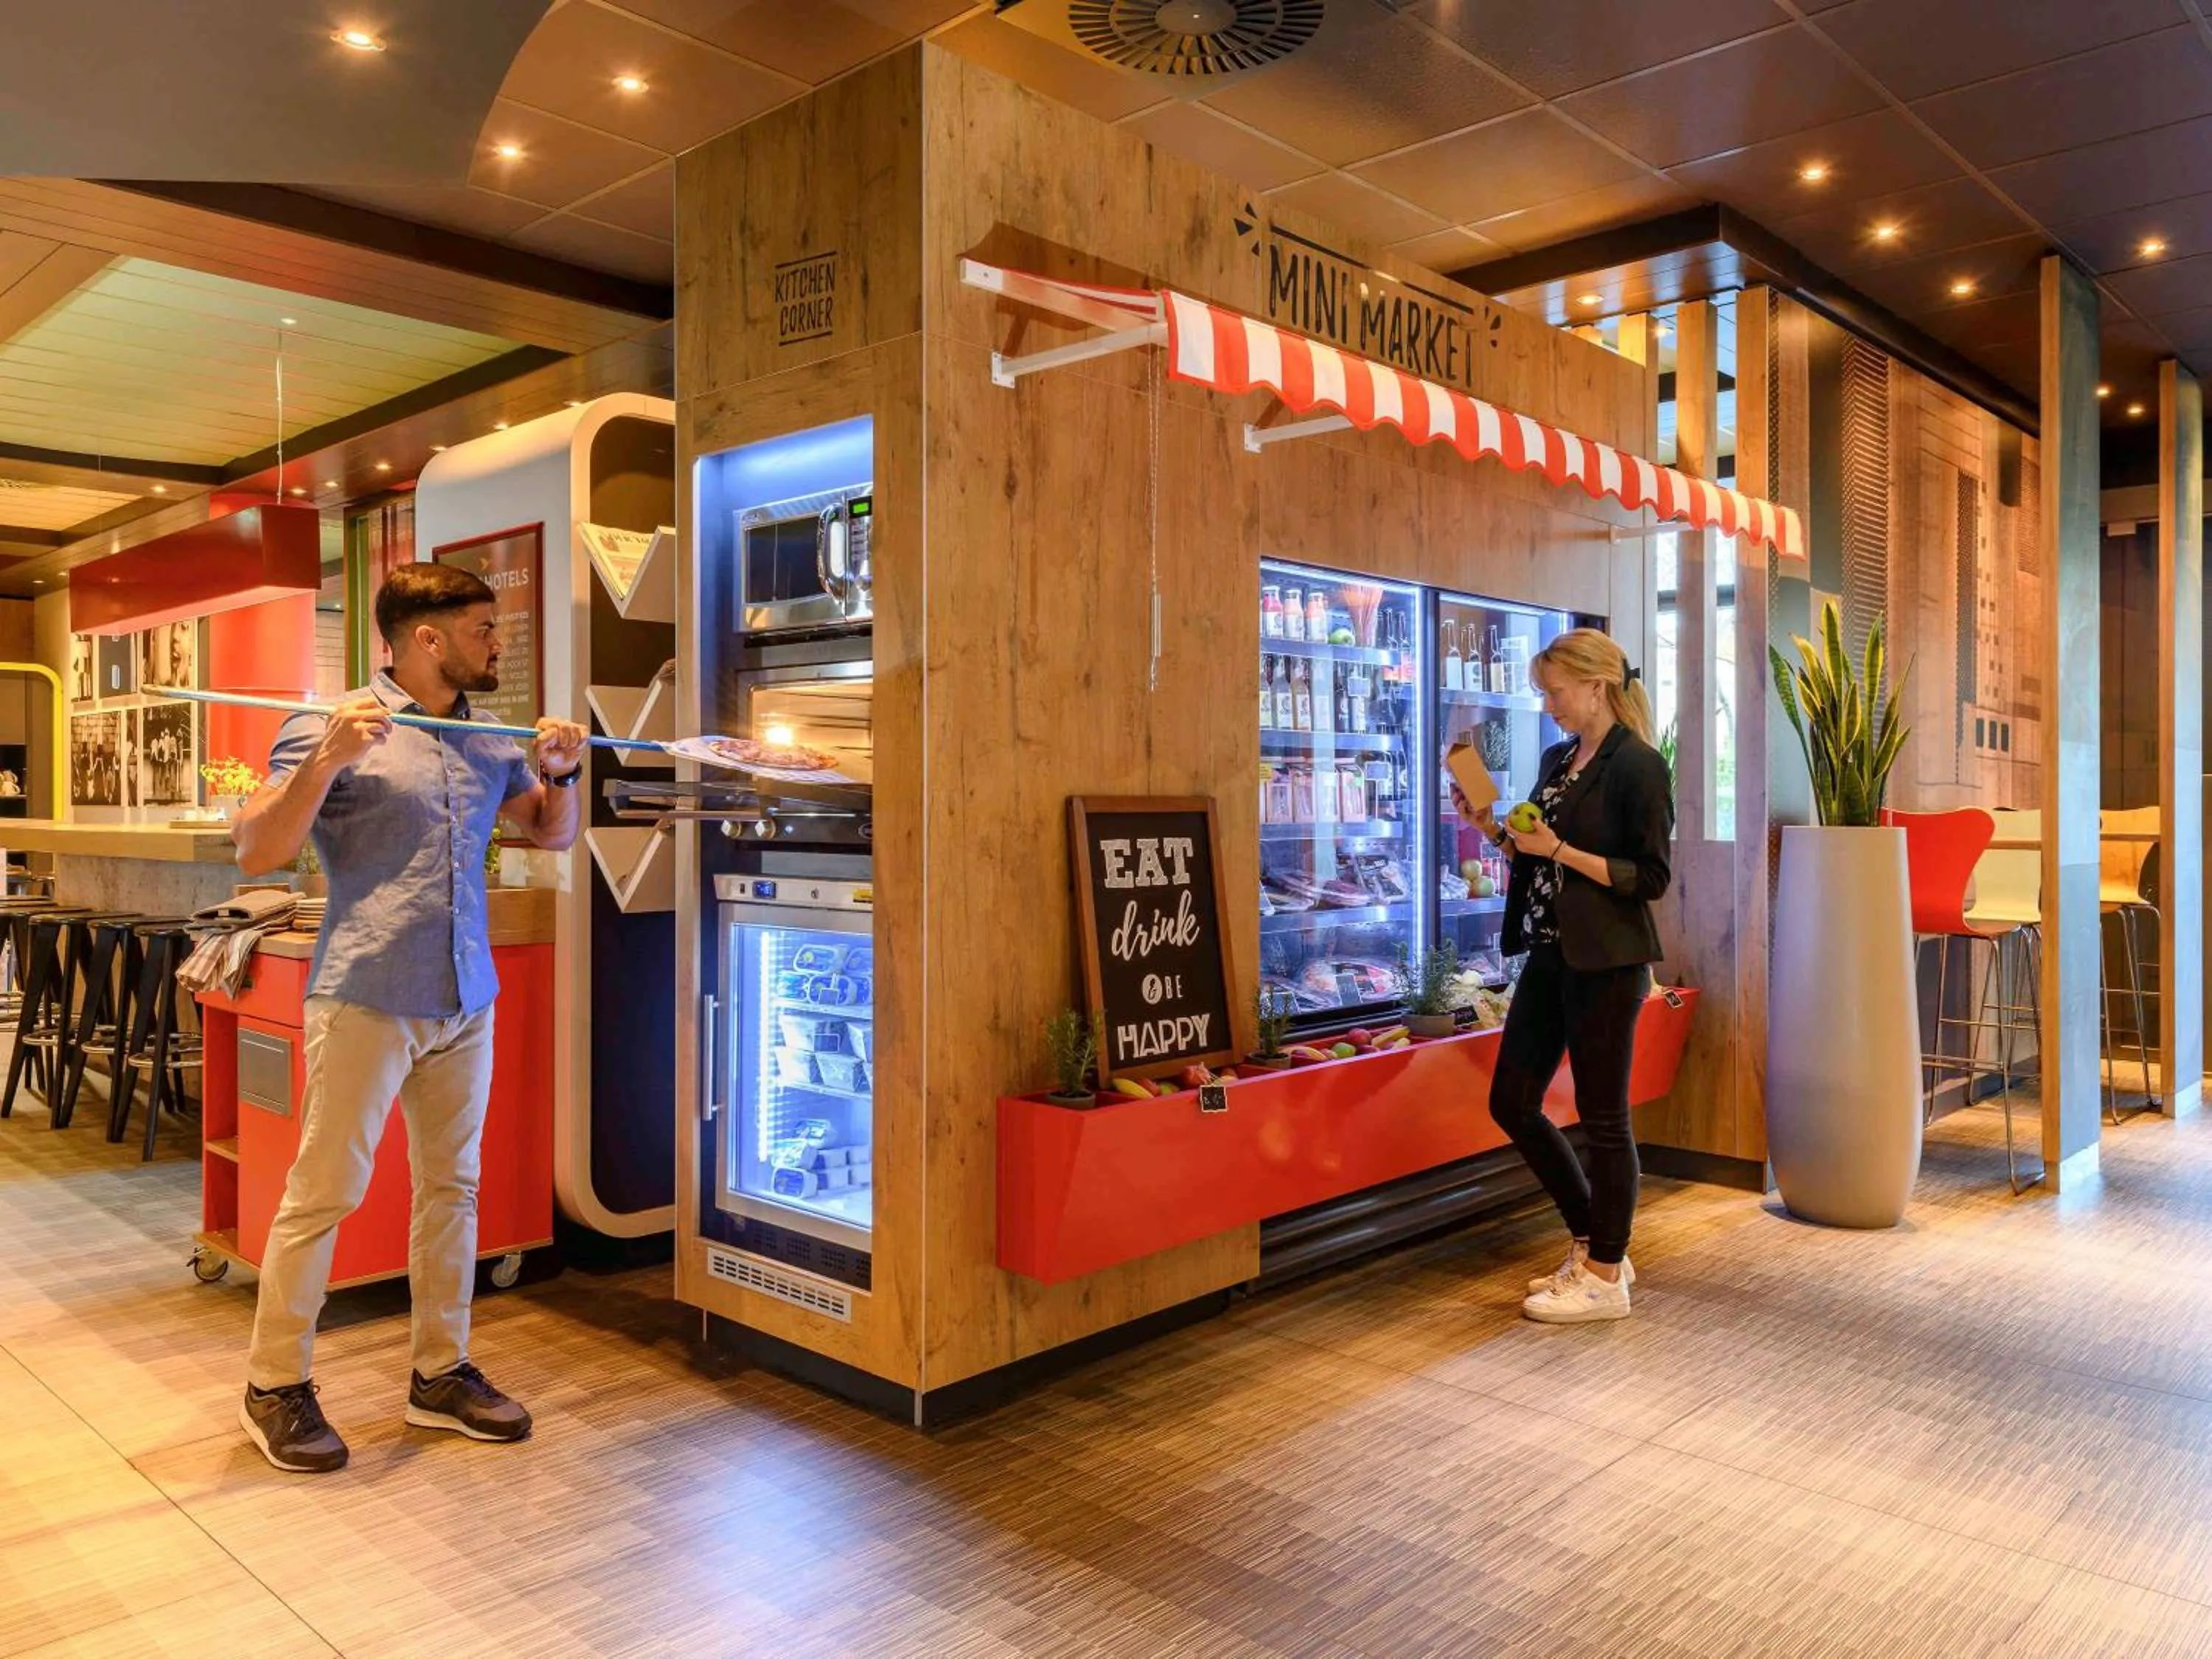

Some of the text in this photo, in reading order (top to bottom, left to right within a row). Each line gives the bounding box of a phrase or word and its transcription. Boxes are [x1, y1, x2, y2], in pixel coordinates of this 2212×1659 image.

[775, 261, 836, 303] KITCHEN
[779, 296, 834, 336] CORNER
[1269, 243, 1472, 388] MINI MARKET
[479, 567, 529, 591] HOTELS
[1099, 837, 1194, 888] EAT
[1110, 888, 1200, 961] drink
[1164, 974, 1183, 999] BE
[1116, 1013, 1211, 1060] HAPPY
